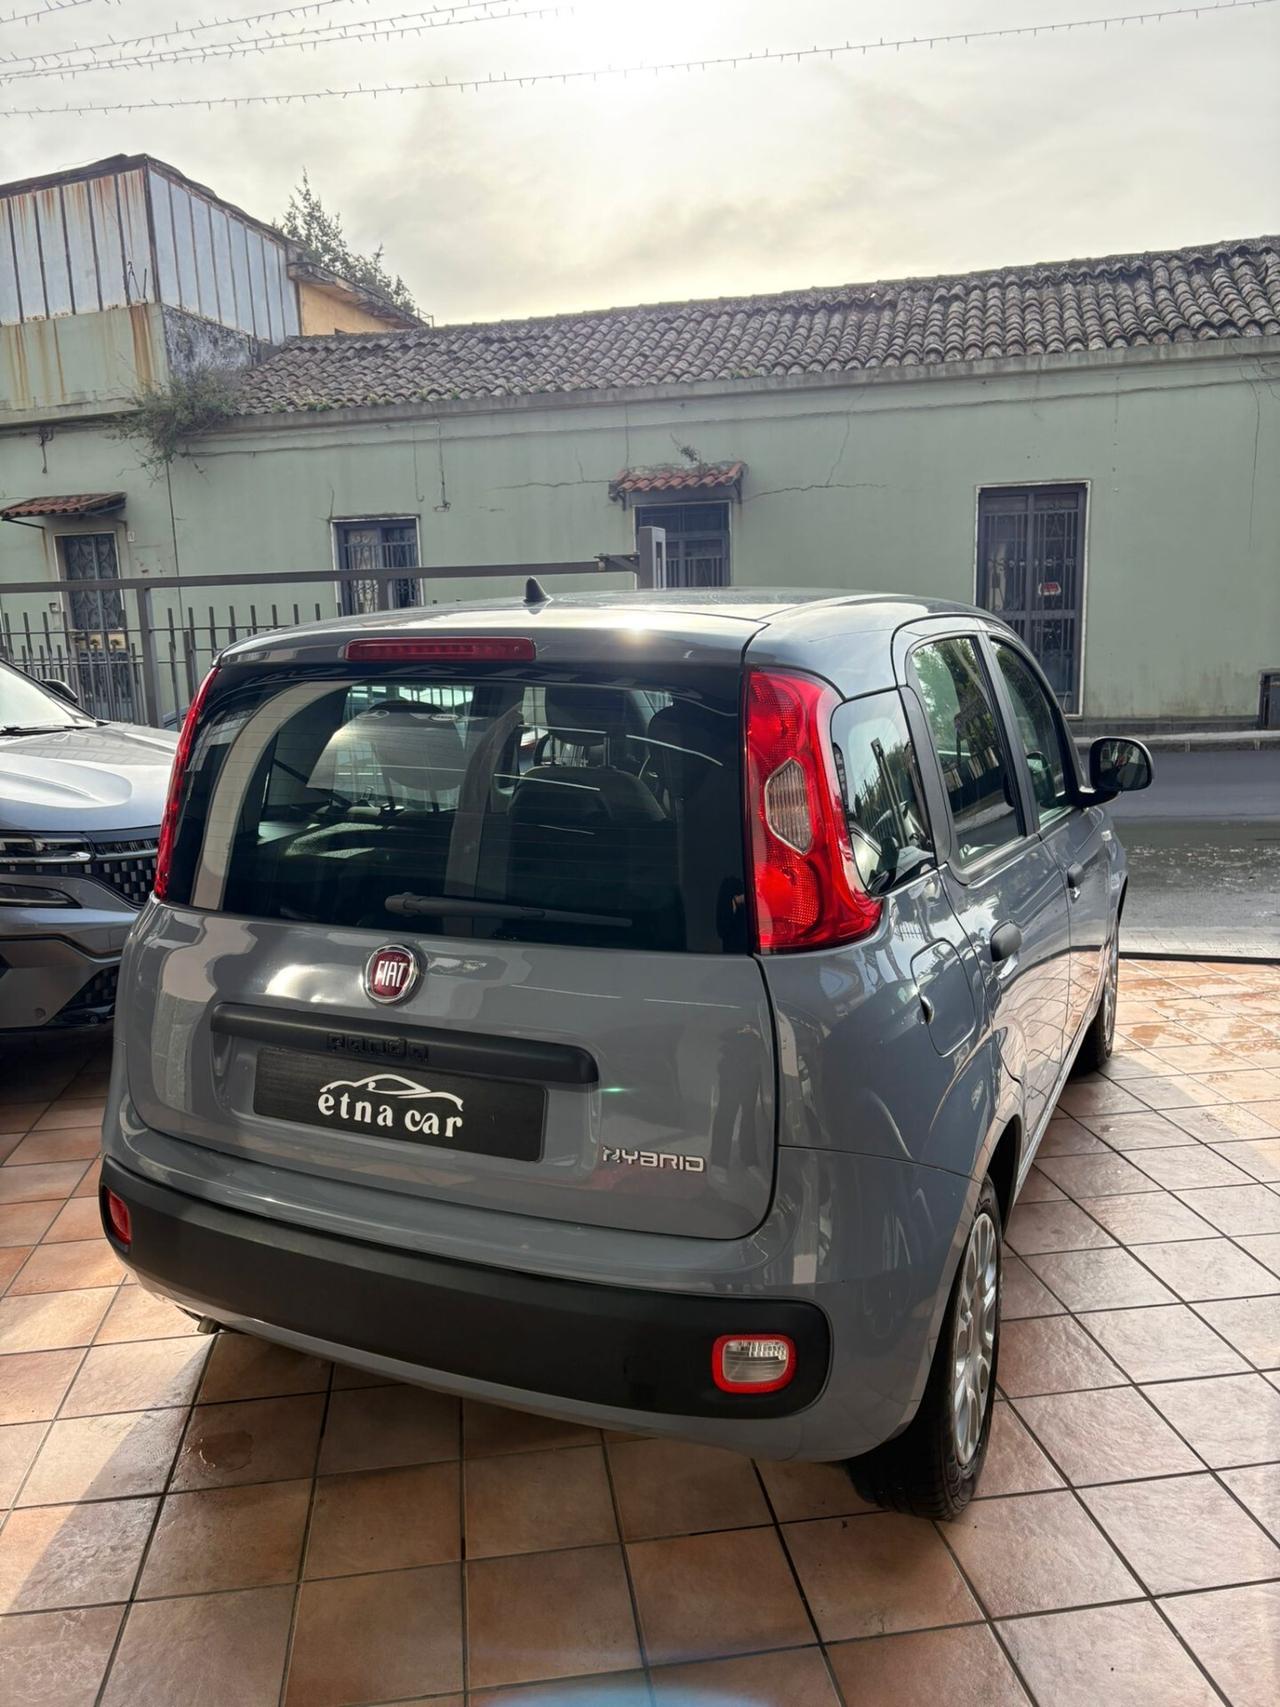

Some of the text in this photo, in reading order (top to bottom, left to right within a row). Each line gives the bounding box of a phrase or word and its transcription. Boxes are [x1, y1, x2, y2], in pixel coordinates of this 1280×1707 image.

[374, 960, 408, 987] FIAT
[317, 1092, 463, 1138] etna car
[602, 1146, 704, 1172] HYBRID
